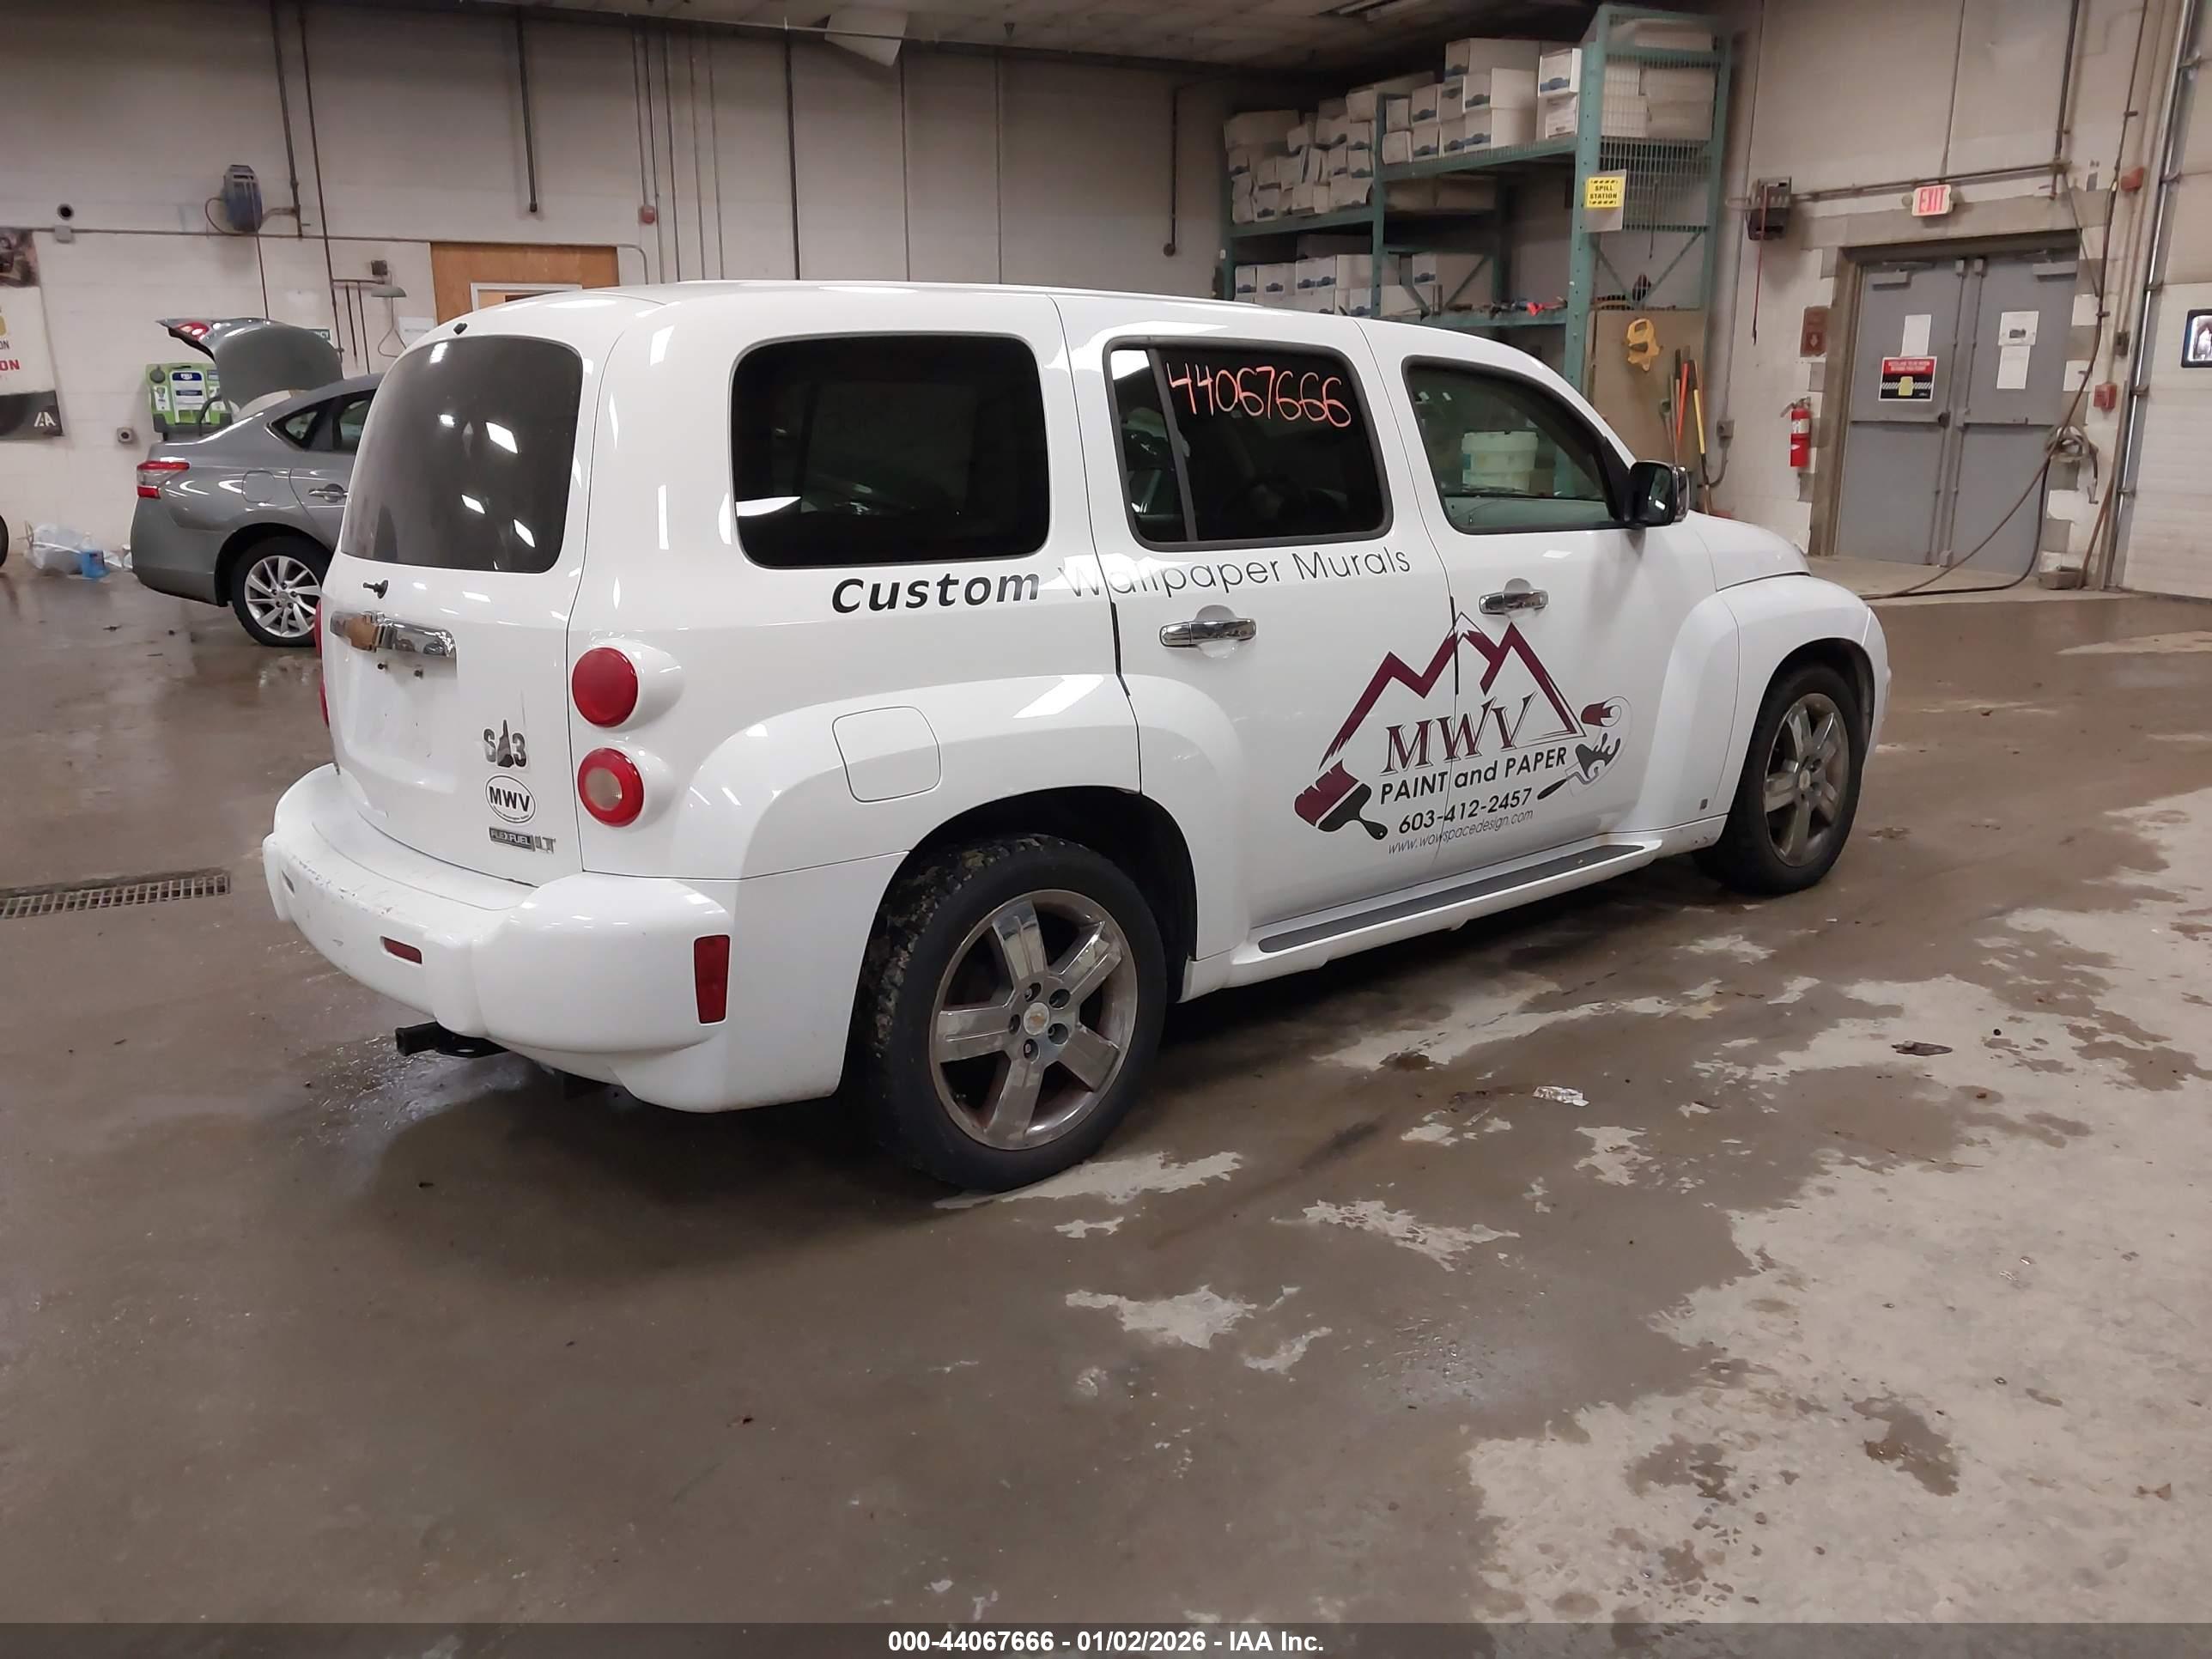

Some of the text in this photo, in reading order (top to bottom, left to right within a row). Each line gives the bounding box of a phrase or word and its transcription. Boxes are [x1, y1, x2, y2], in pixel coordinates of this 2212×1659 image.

[1918, 186, 1946, 214] EXIT
[1166, 362, 1352, 428] 44067666
[831, 546, 1411, 614] Custom Wallpaper Murals
[1379, 691, 1538, 776] MWV
[489, 786, 530, 812] MWV
[1380, 745, 1568, 805] PAINT and PAPER
[1388, 808, 1534, 855] www.wowspacedesign.com
[1399, 787, 1533, 834] 603-412-2457
